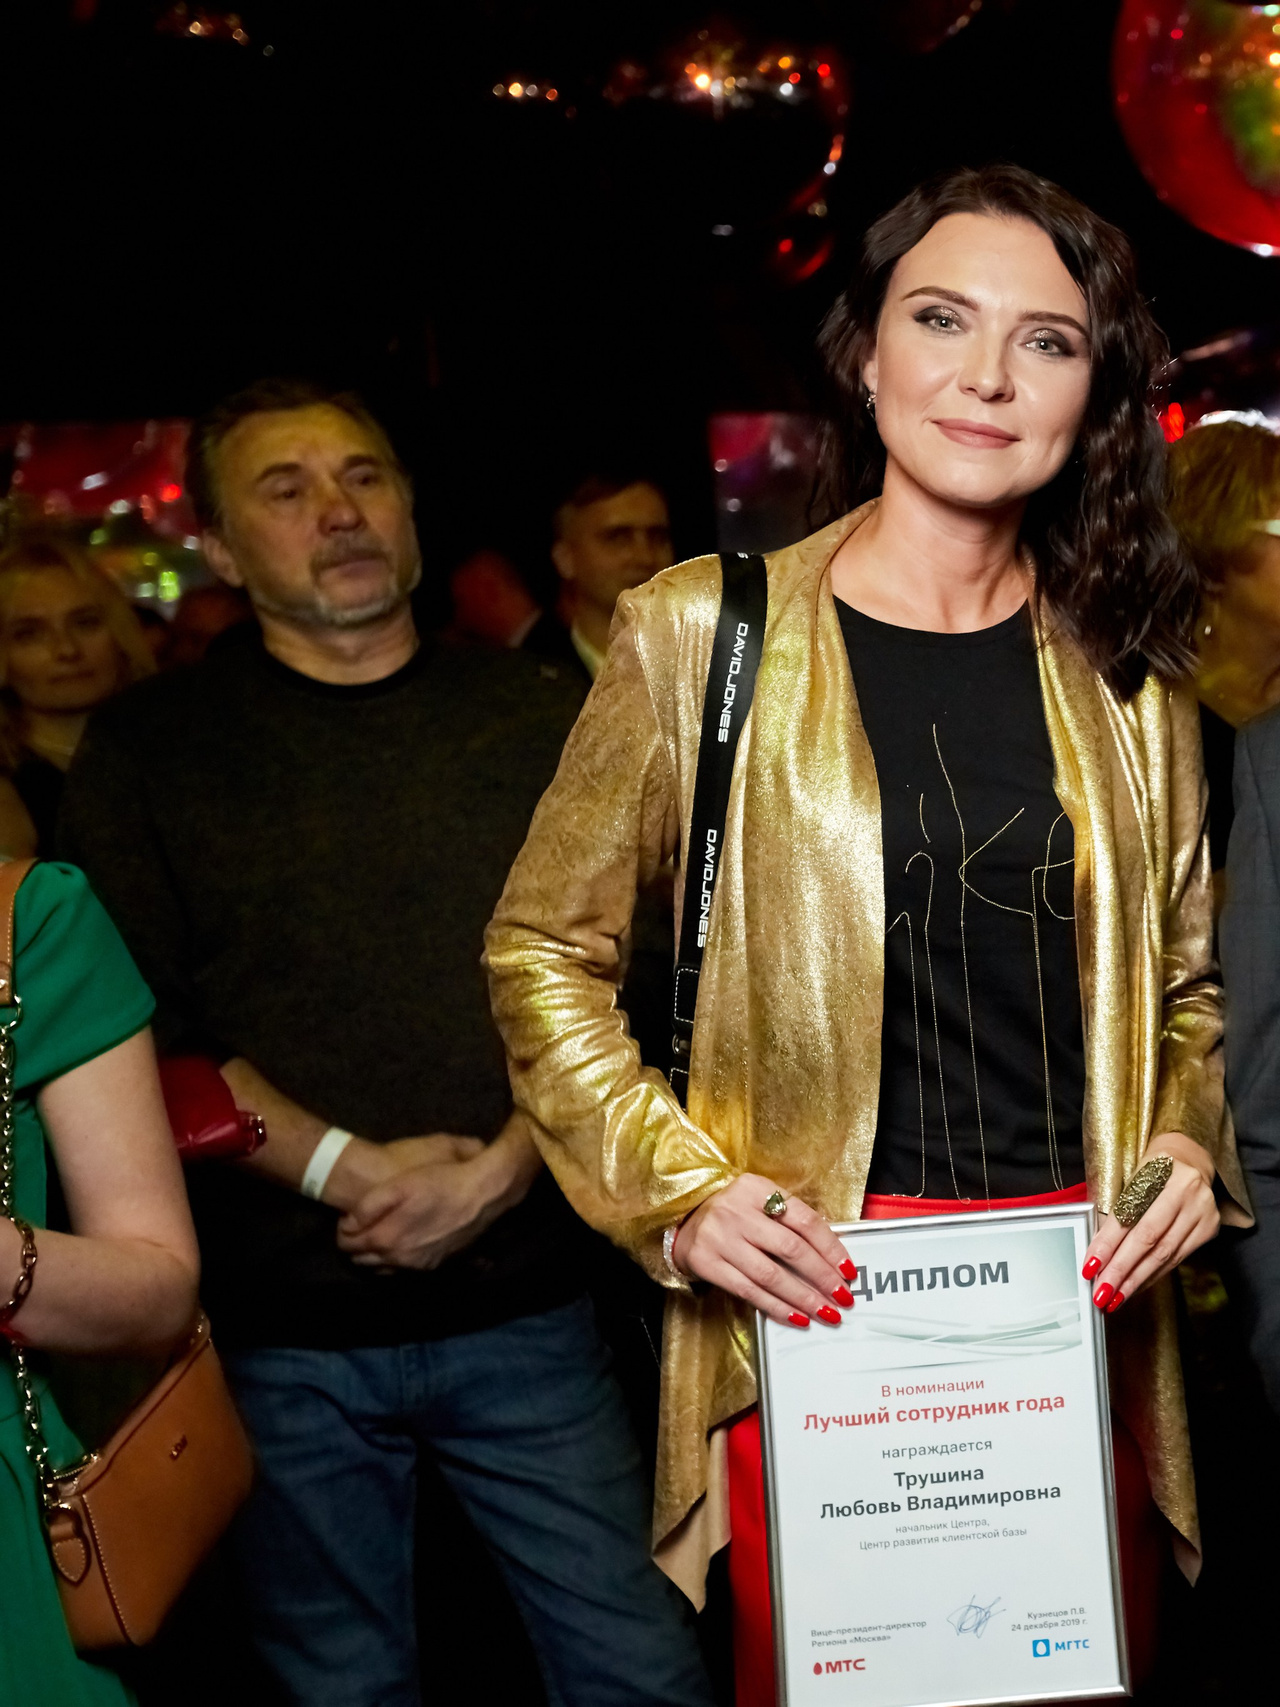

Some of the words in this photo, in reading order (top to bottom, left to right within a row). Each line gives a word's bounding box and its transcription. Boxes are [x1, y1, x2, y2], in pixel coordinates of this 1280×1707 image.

[851, 1261, 1009, 1301] Диплом
[881, 1385, 891, 1397] В
[896, 1379, 984, 1397] номинации
[804, 1407, 890, 1433] Лучший
[896, 1399, 1009, 1423] сотрудник
[1016, 1396, 1065, 1413] года
[882, 1439, 992, 1460] награждается
[894, 1466, 984, 1490] Трушина
[820, 1500, 901, 1519] Любовь
[907, 1484, 1061, 1512] Владимировна
[895, 1521, 948, 1534] начальник
[859, 1538, 890, 1551] Центр
[893, 1535, 939, 1549] развития
[942, 1529, 999, 1543] клиентской
[1002, 1527, 1027, 1538] базы
[1028, 1610, 1068, 1621] Кузнецов
[811, 1620, 926, 1637] Вице-президент-директор
[1023, 1620, 1058, 1632] декабря
[1061, 1619, 1081, 1627] 2019
[812, 1637, 847, 1648] Региона
[1055, 1639, 1090, 1652] МГТС
[826, 1658, 866, 1673] МТС
